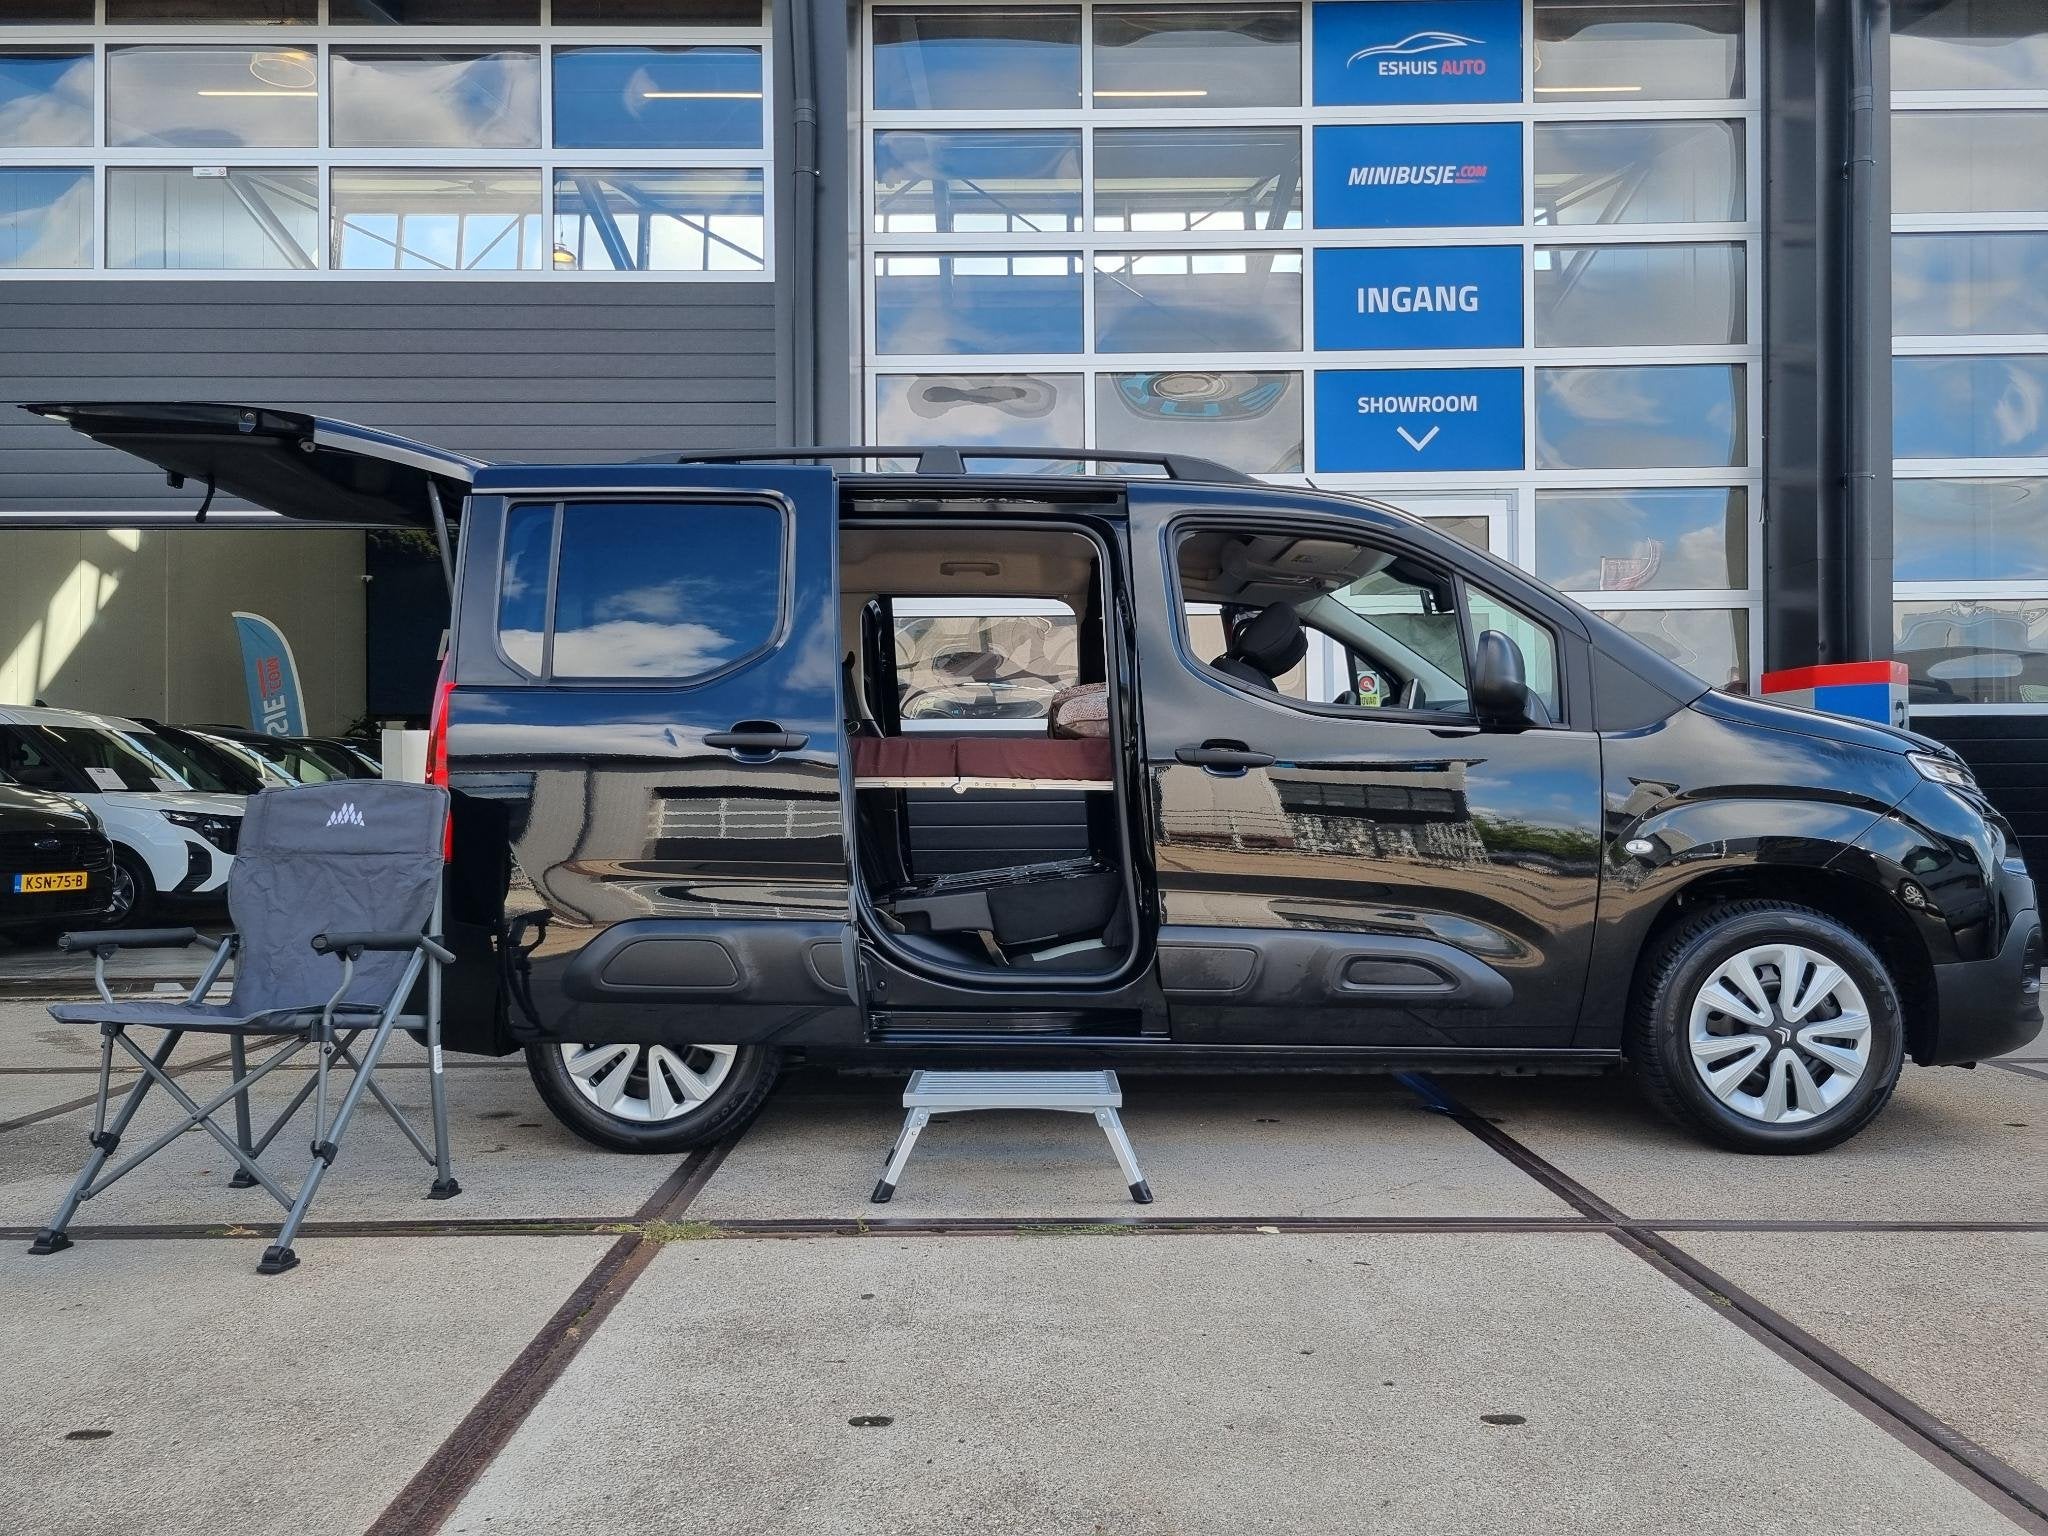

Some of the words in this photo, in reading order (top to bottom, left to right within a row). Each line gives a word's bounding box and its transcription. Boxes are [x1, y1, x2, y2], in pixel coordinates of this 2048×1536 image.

[1378, 61, 1438, 76] ESHUIS
[1441, 59, 1486, 75] AUTO
[1348, 165, 1488, 185] MINIBUSJE.COM
[1357, 285, 1478, 313] INGANG
[1357, 395, 1477, 413] SHOWROOM
[26, 875, 83, 890] KSN-75-B
